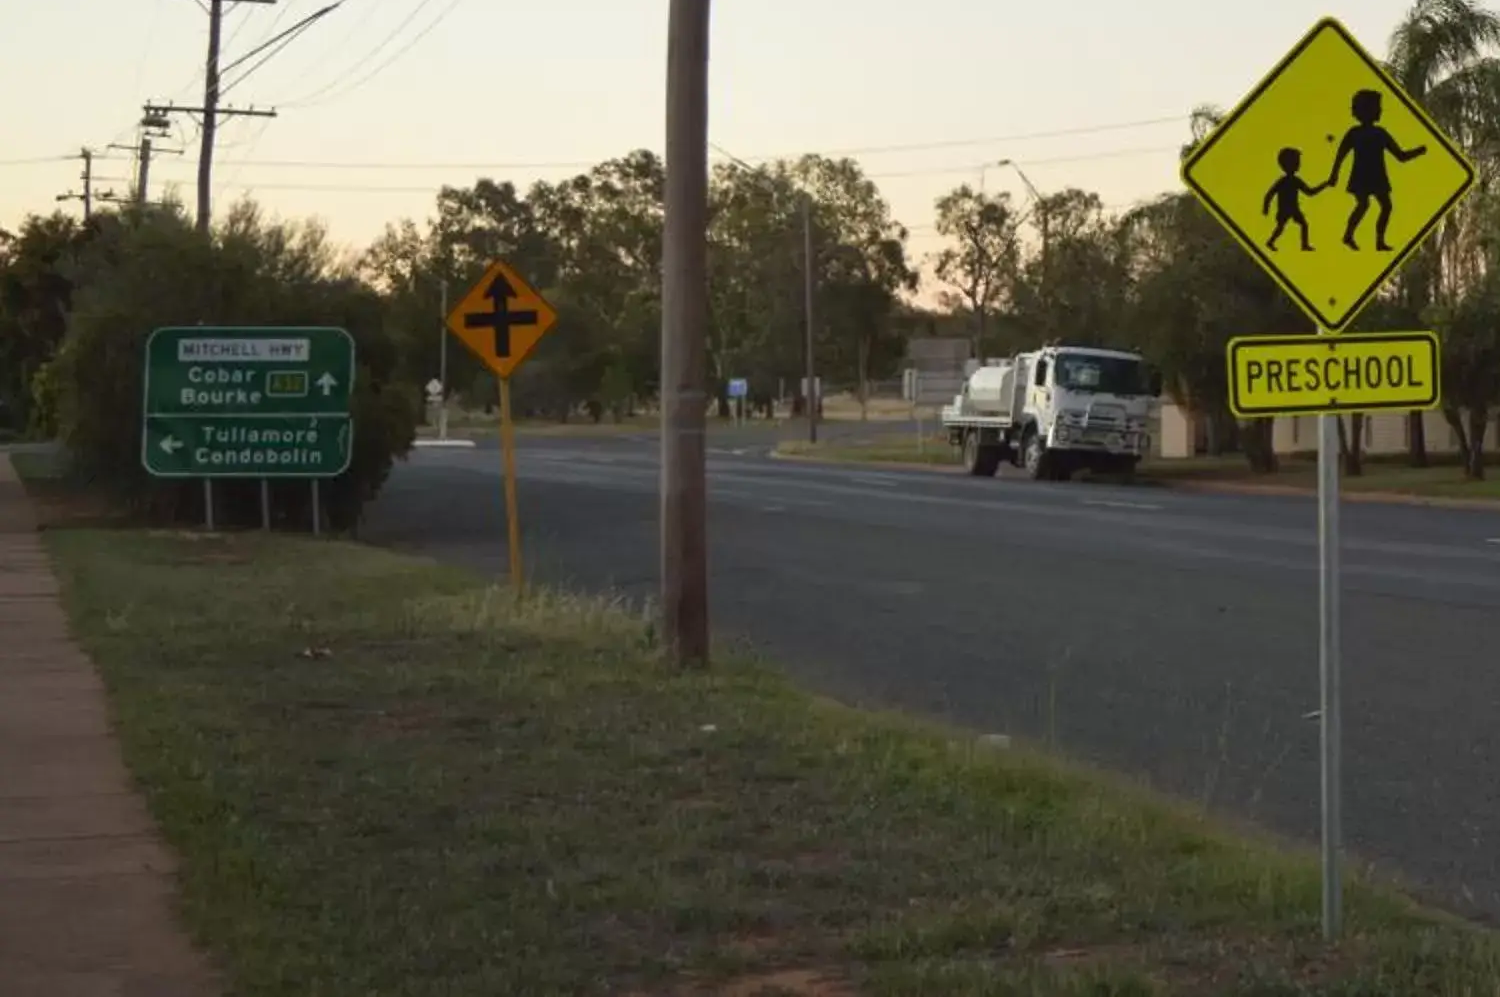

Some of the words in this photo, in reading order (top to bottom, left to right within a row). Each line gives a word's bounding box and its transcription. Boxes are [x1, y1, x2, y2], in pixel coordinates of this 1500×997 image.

[183, 342, 260, 357] MITCHELL
[268, 342, 304, 357] HWY
[188, 366, 256, 383] Cobar
[1246, 354, 1424, 394] PRESCHOOL
[180, 388, 262, 404] Bourke
[202, 426, 319, 443] Tullamore
[195, 448, 322, 464] Condobolin
